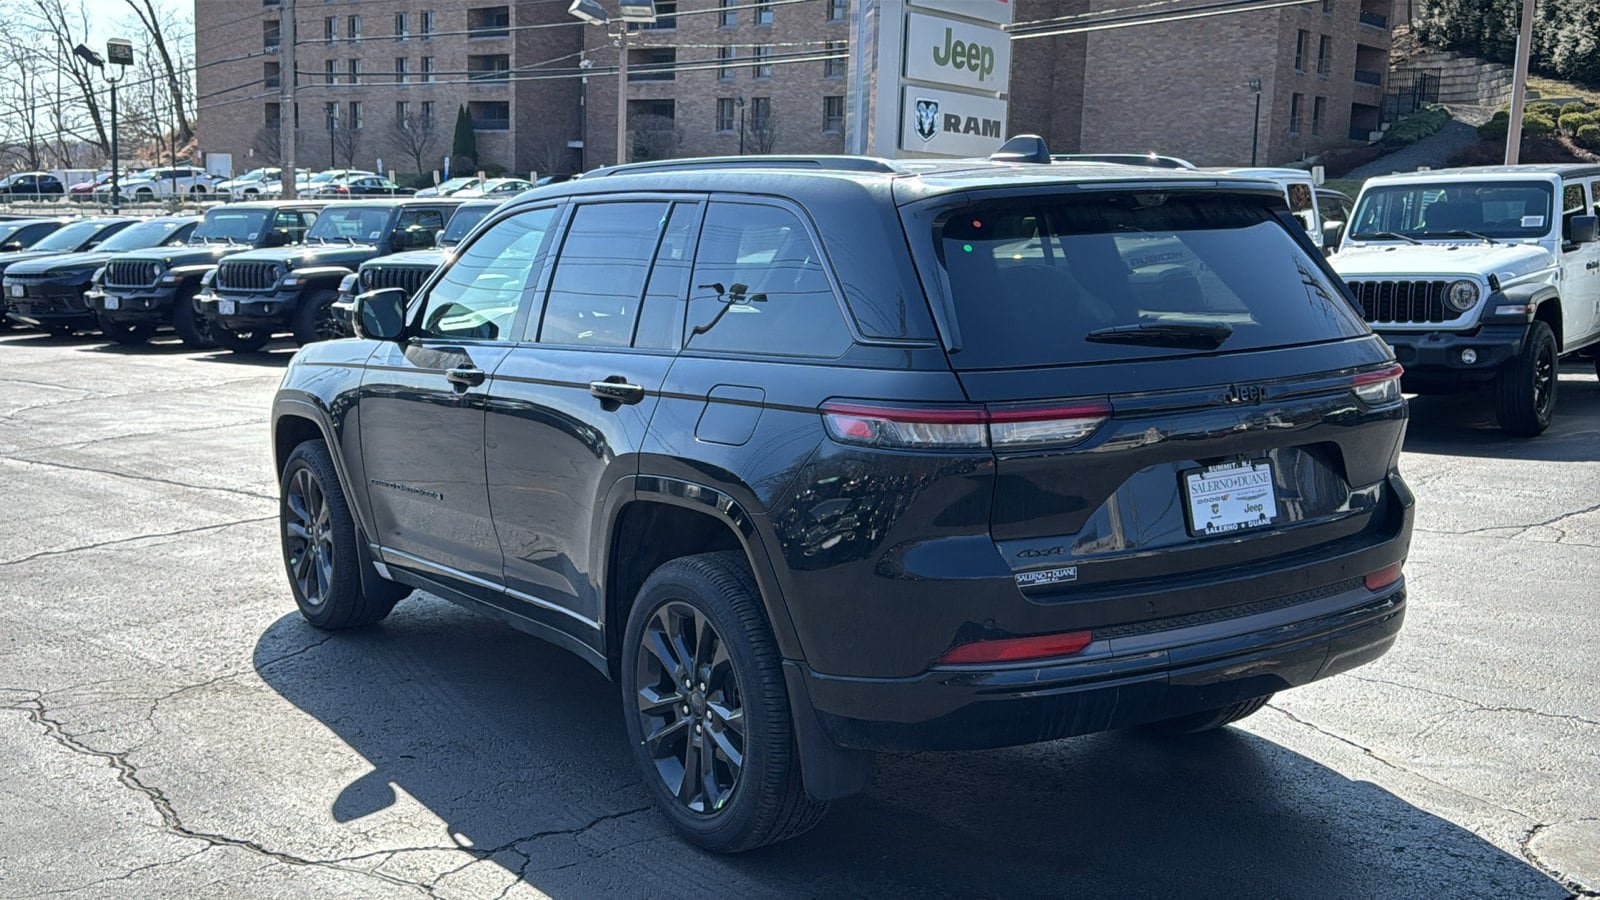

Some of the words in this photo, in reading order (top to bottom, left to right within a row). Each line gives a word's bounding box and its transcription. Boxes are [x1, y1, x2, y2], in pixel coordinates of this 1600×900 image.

[933, 27, 995, 81] Jeep
[943, 113, 1001, 138] RAM
[1224, 384, 1268, 405] Jeep
[1244, 503, 1264, 514] Jeep
[1204, 523, 1238, 535] SALERNO
[1248, 519, 1272, 528] DUANE
